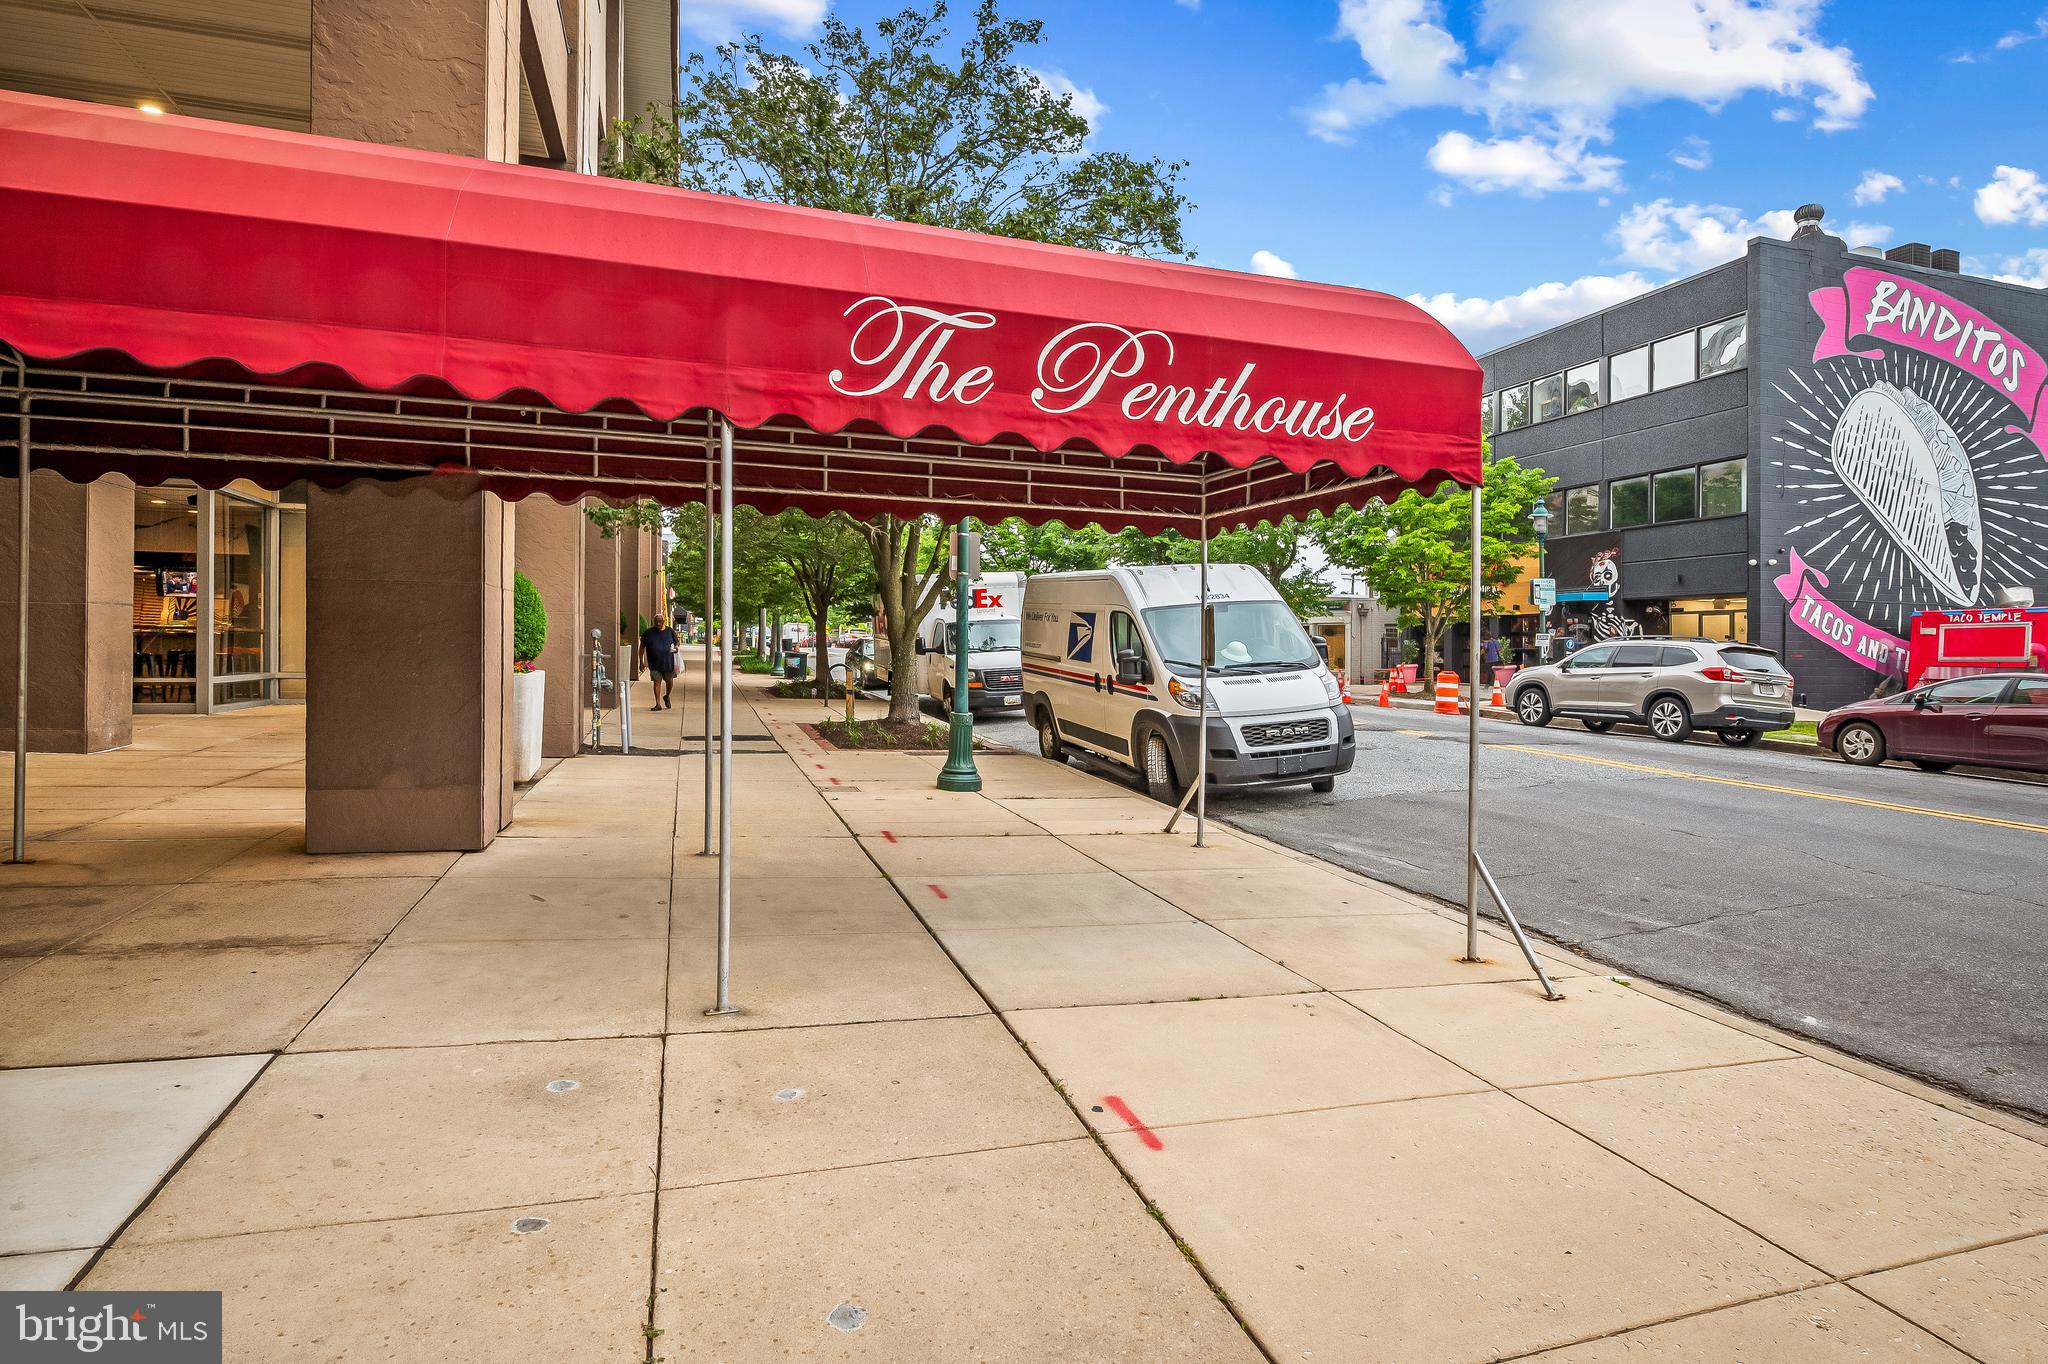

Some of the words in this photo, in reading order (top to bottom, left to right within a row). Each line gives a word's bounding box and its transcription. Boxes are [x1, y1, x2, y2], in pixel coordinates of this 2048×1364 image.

[829, 296, 996, 404] The
[1031, 322, 1375, 443] Penthouse
[1865, 280, 2026, 392] BANDITOS
[1800, 594, 1854, 646] TACOS
[1856, 635, 1889, 664] AND
[1948, 613, 1973, 622] TACO
[1977, 612, 2022, 623] TEMPLE
[1265, 726, 1309, 737] RAM
